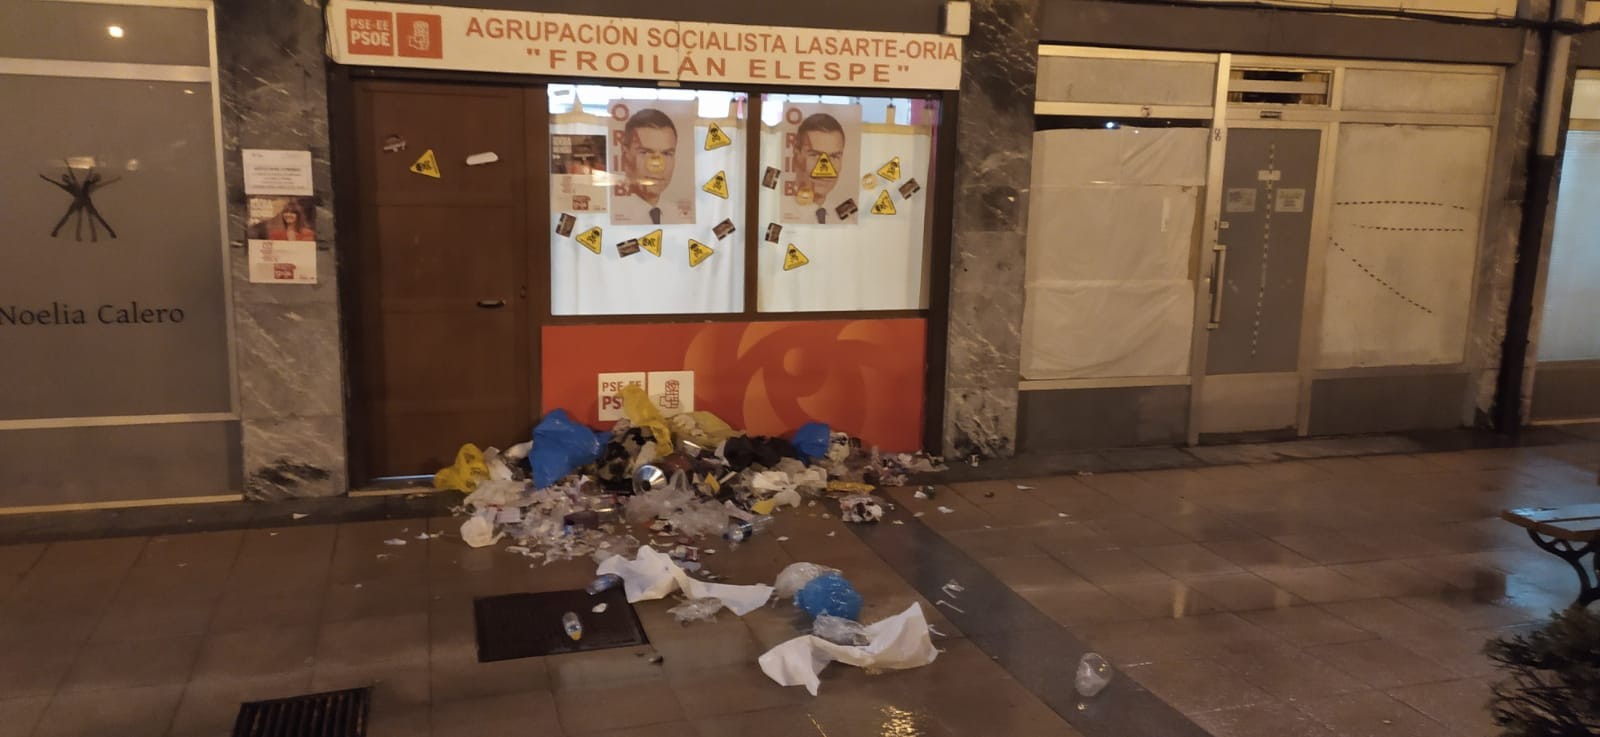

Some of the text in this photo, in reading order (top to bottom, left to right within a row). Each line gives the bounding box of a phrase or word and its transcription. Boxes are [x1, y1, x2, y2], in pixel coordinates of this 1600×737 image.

[350, 18, 390, 31] PSE-EE
[351, 31, 391, 47] PSOE
[465, 17, 958, 60] AGRUPACIÓN SOCIALISTA LASARTE-ORIA
[749, 59, 910, 82] ELESPE"
[0, 301, 185, 325] Noelia Calero
